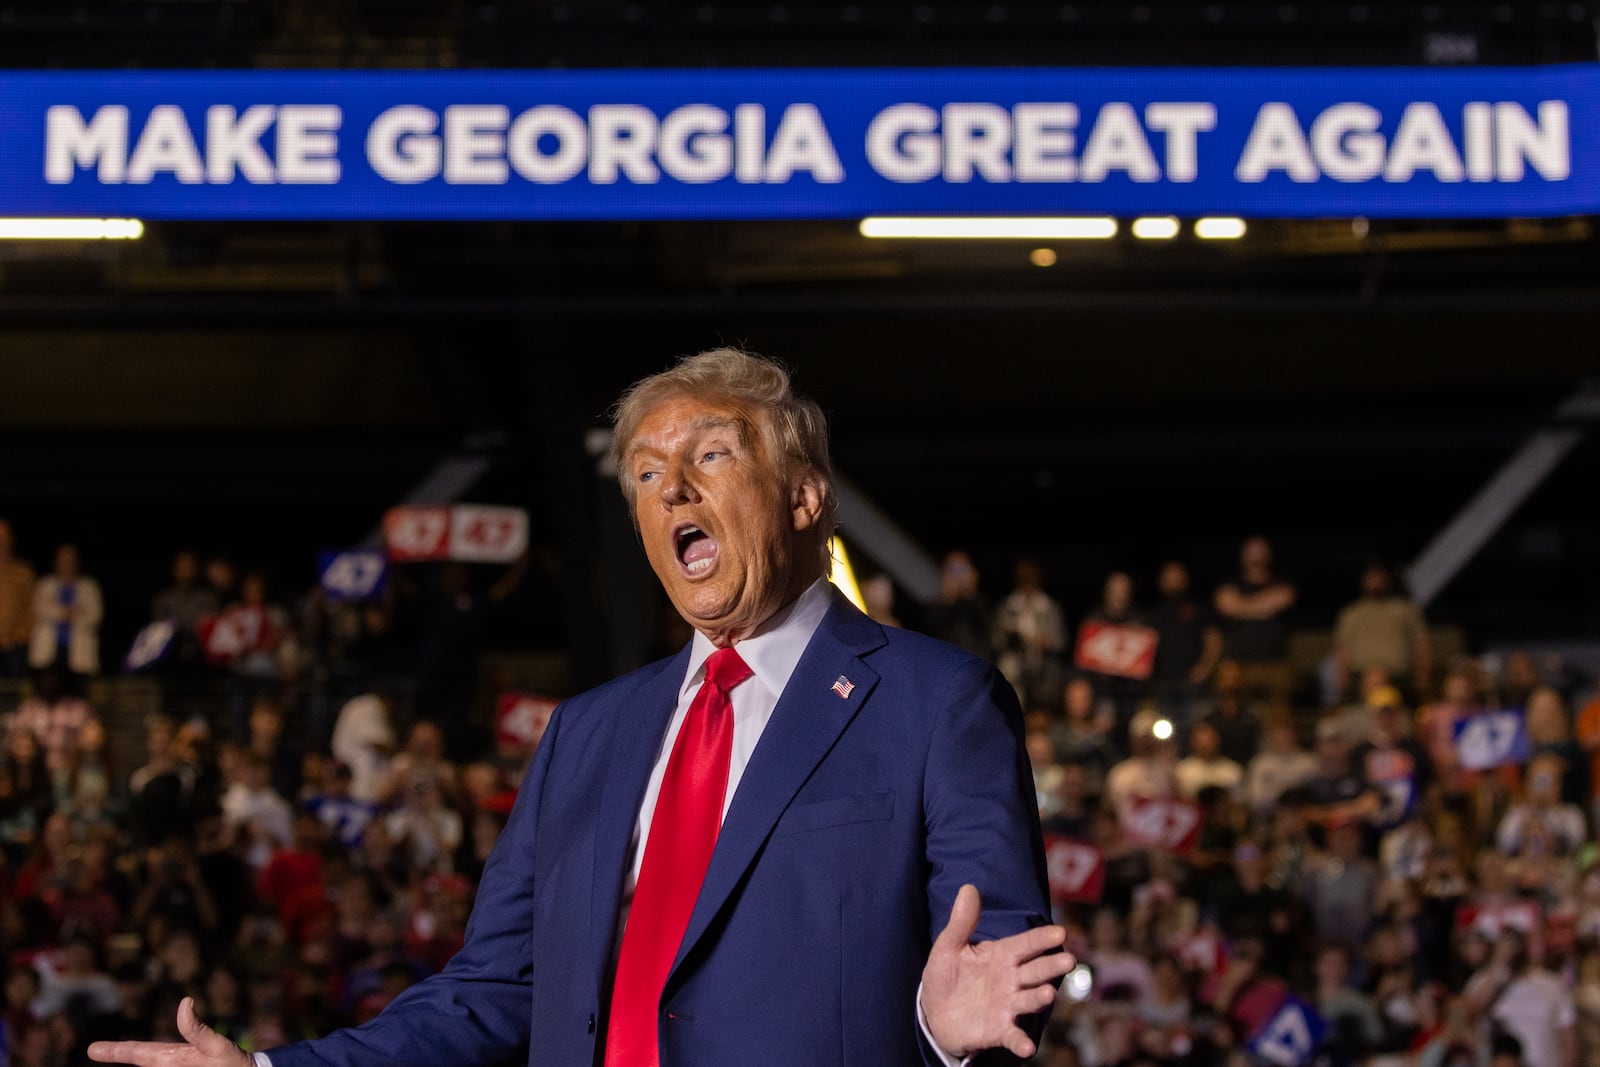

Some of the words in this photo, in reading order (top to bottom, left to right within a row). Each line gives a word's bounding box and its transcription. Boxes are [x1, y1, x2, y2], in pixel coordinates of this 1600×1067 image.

[44, 104, 342, 185] MAKE
[367, 104, 844, 185] GEORGIA
[865, 101, 1216, 184] GREAT
[1236, 100, 1569, 183] AGAIN
[389, 510, 447, 554] 47
[463, 515, 518, 553] 47
[321, 554, 384, 597] 47
[207, 610, 258, 655] 47
[1081, 630, 1150, 672] 47
[1458, 712, 1516, 768] 47
[1131, 800, 1199, 847] 47
